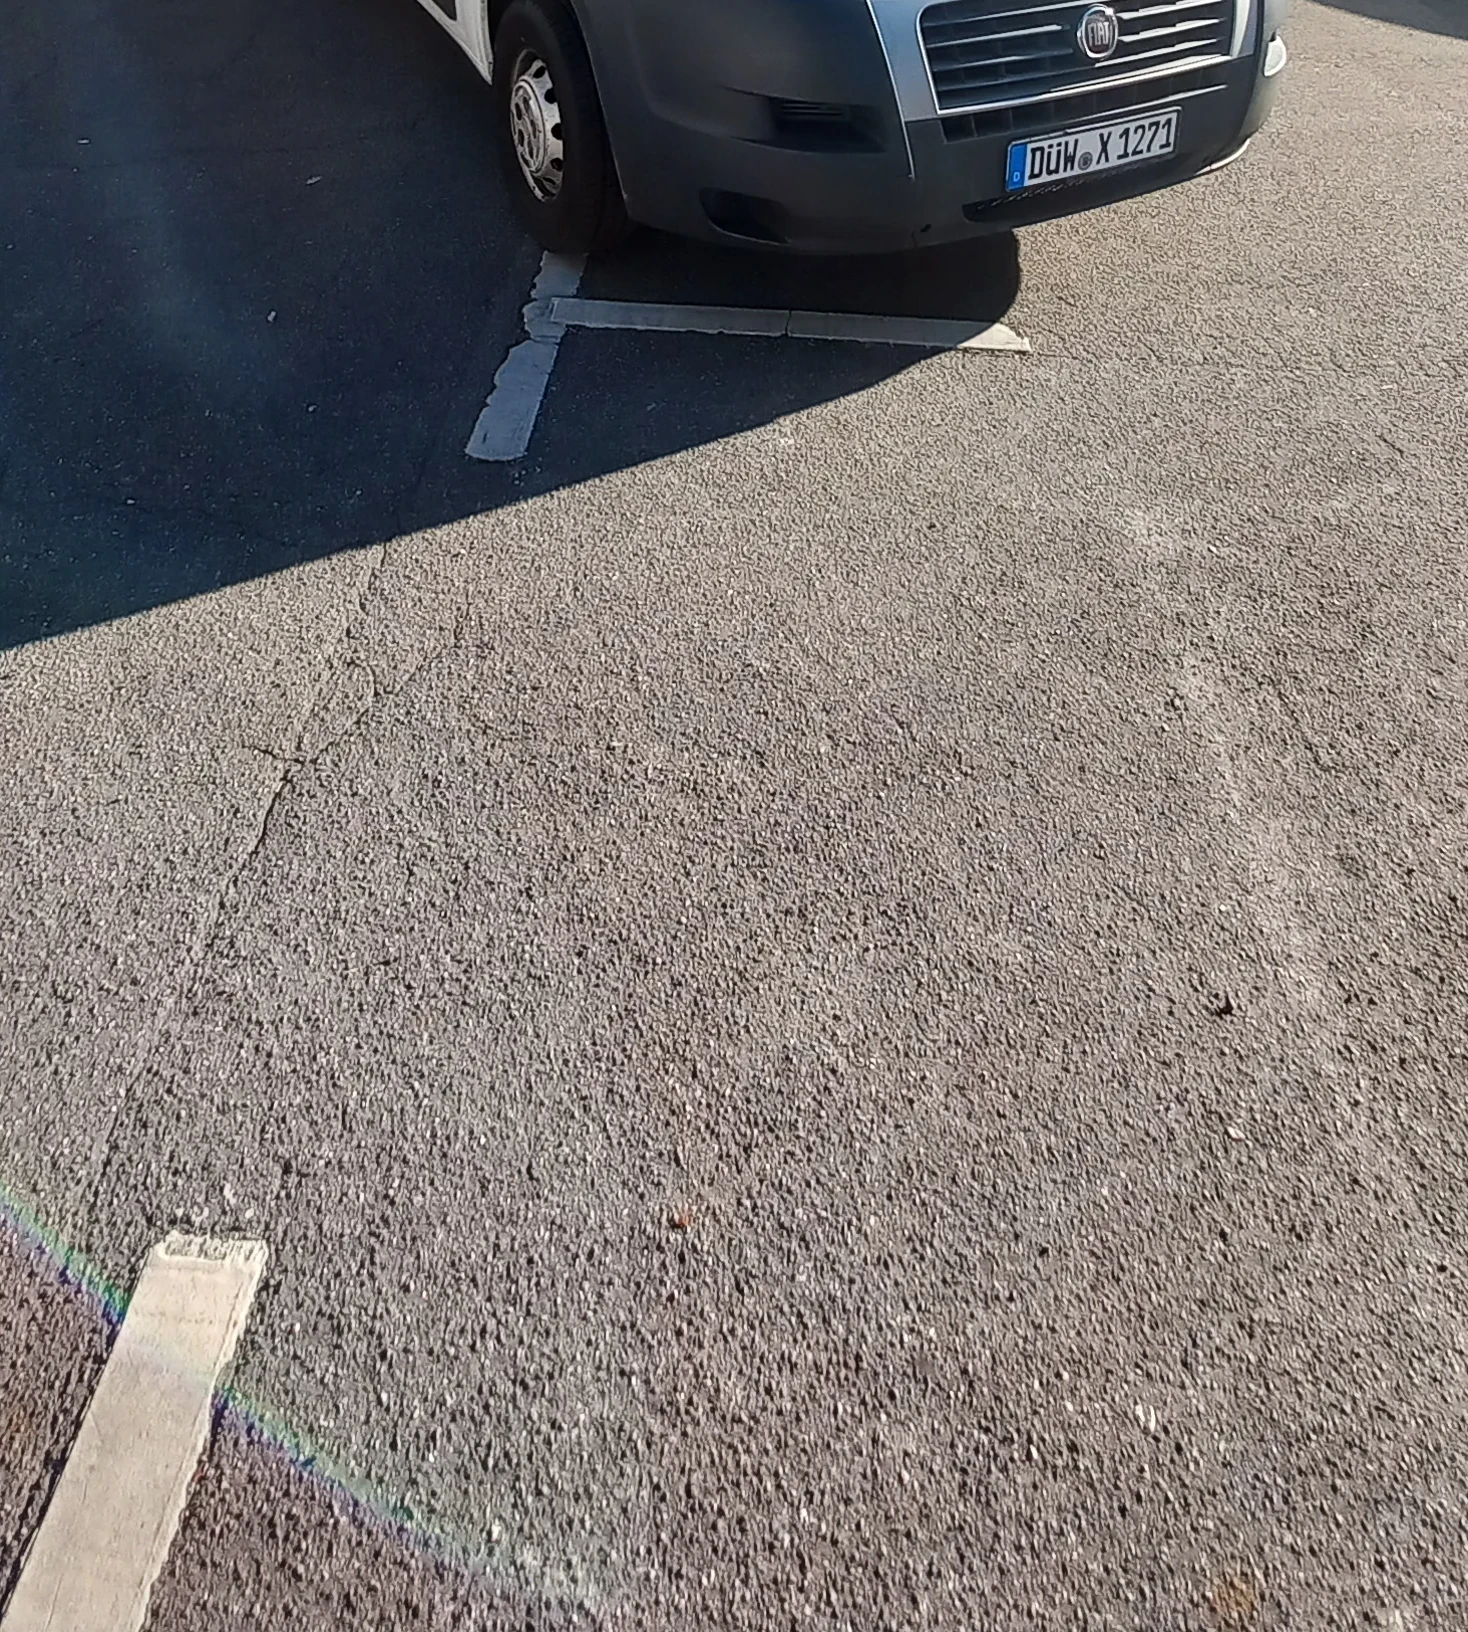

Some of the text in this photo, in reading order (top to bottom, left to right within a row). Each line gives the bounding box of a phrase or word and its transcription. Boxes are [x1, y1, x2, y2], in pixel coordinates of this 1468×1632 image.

[1087, 21, 1110, 47] FIAT
[1028, 118, 1172, 180] DÜW X 1271
[1013, 172, 1020, 182] D
